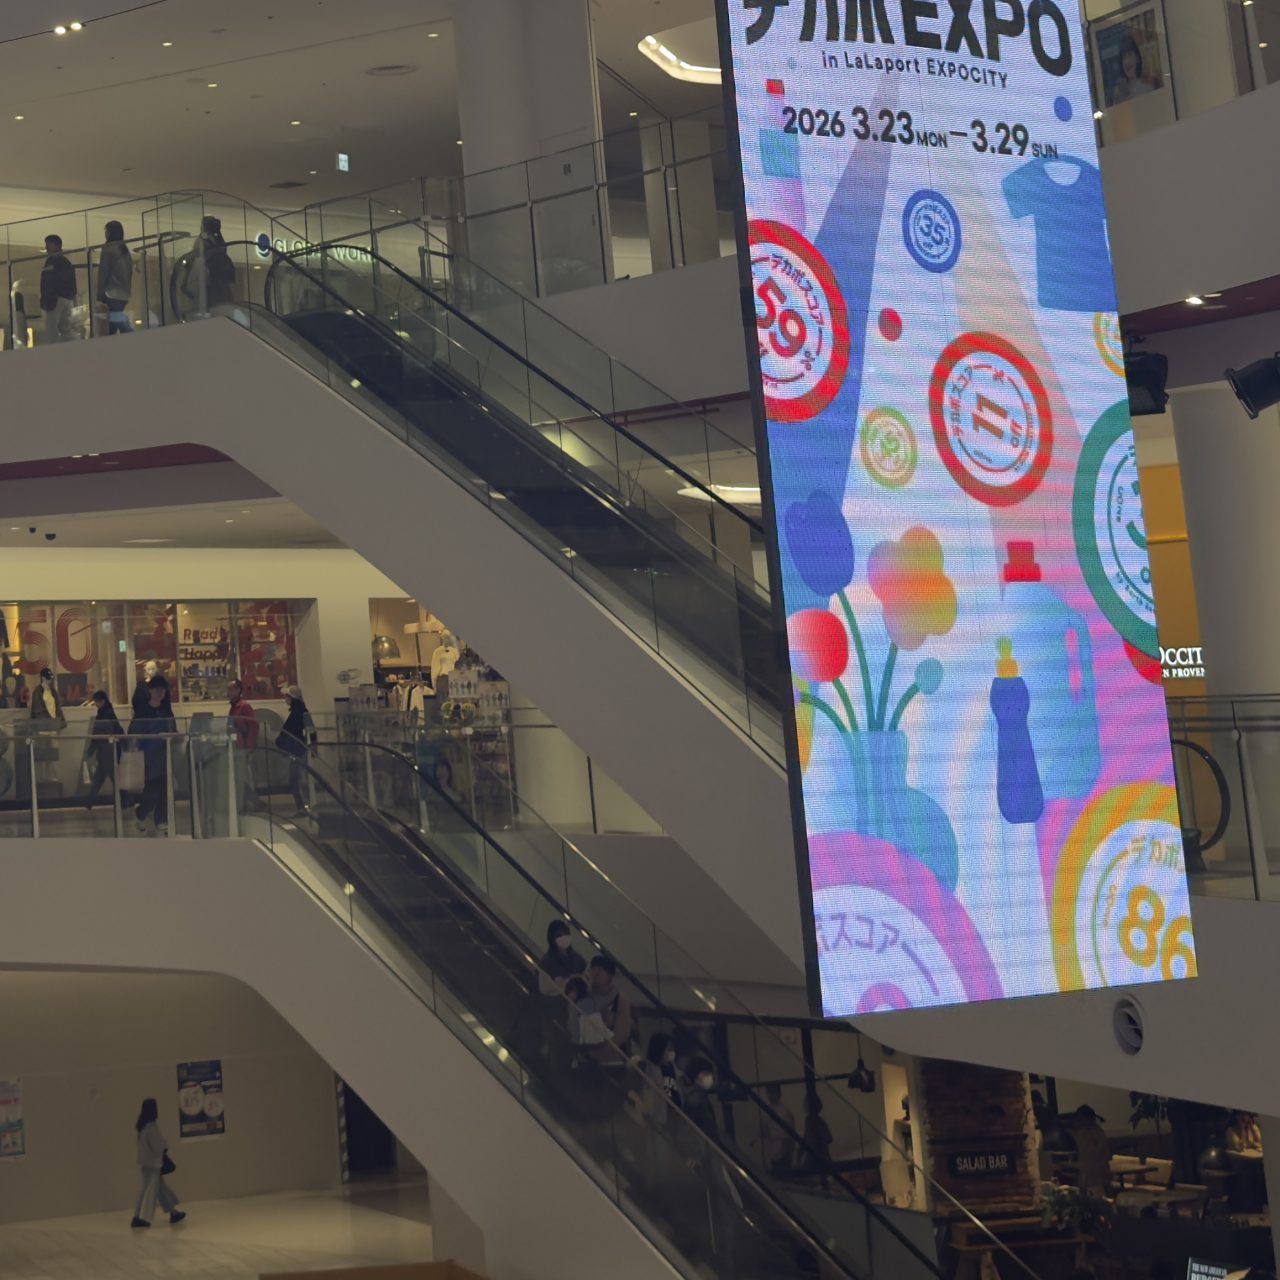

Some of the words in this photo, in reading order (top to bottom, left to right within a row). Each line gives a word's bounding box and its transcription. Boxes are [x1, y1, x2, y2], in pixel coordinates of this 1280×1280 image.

[822, 50, 839, 68] in
[844, 52, 920, 75] LaLaport
[926, 58, 1008, 88] EXPOCITY
[782, 106, 846, 138] 2026
[956, 1156, 986, 1172] SALAD
[989, 1154, 1008, 1170] BAR
